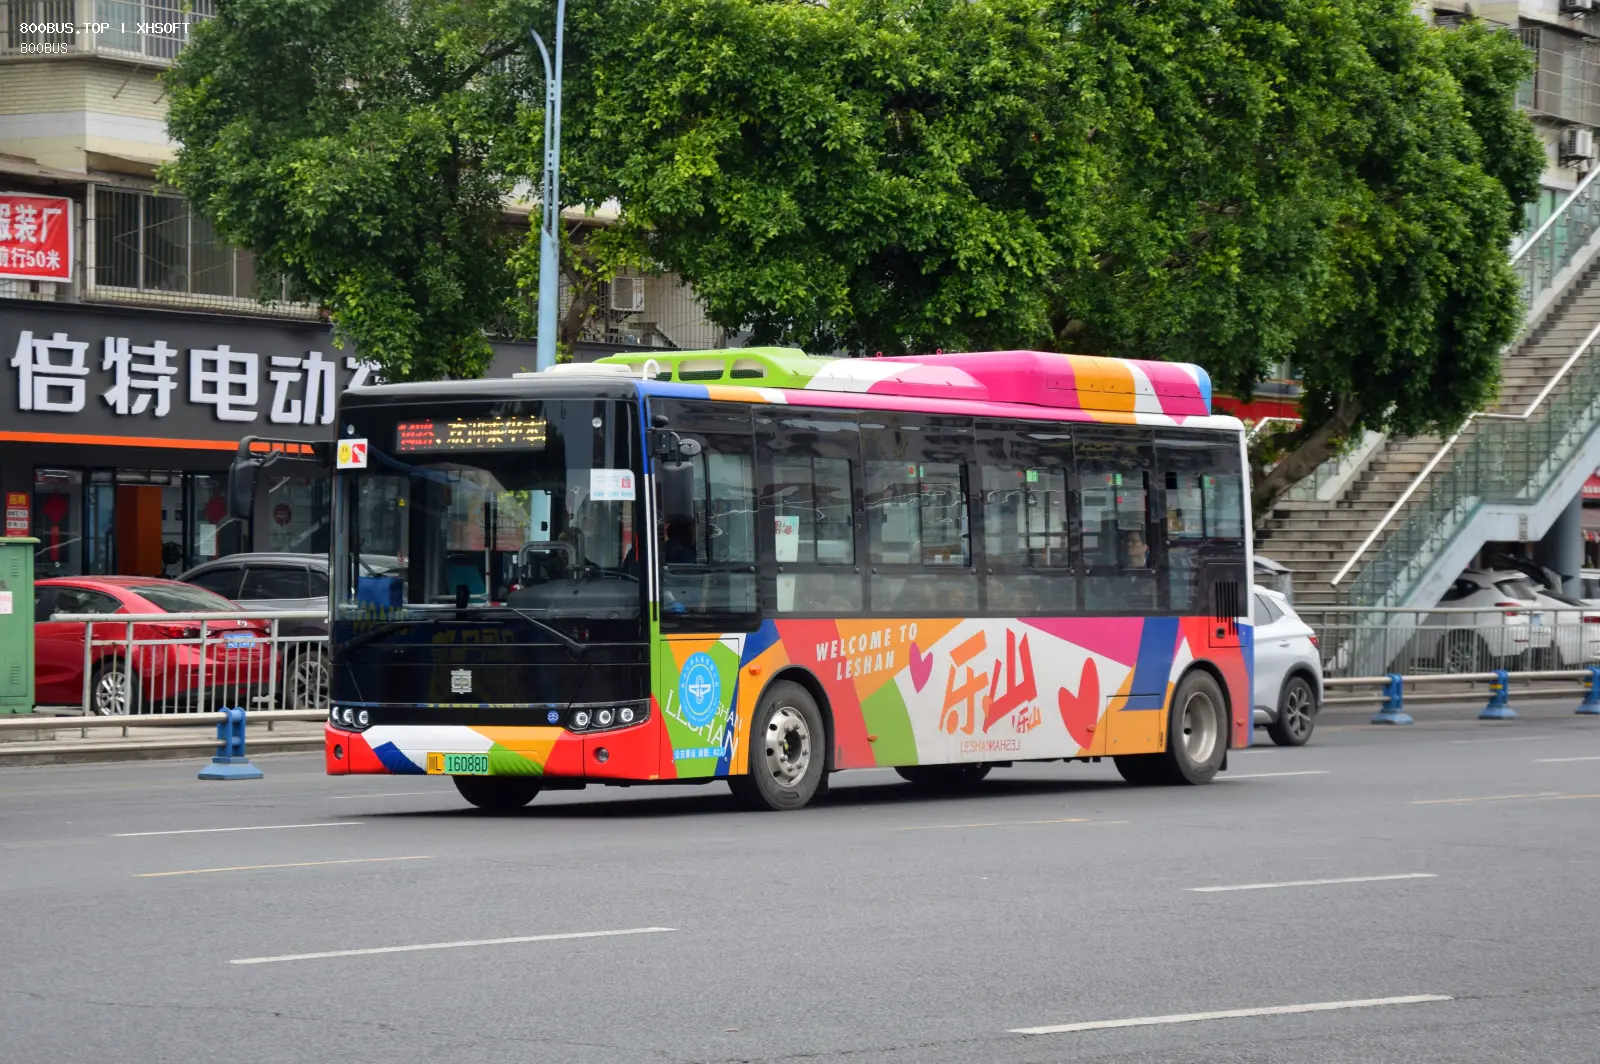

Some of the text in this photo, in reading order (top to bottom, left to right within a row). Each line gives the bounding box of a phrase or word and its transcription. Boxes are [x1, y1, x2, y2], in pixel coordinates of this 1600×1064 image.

[816, 622, 918, 662] WELCOME TO
[837, 649, 895, 681] LESHAN
[938, 627, 1038, 736] 乐山
[448, 756, 488, 772] 16088D
